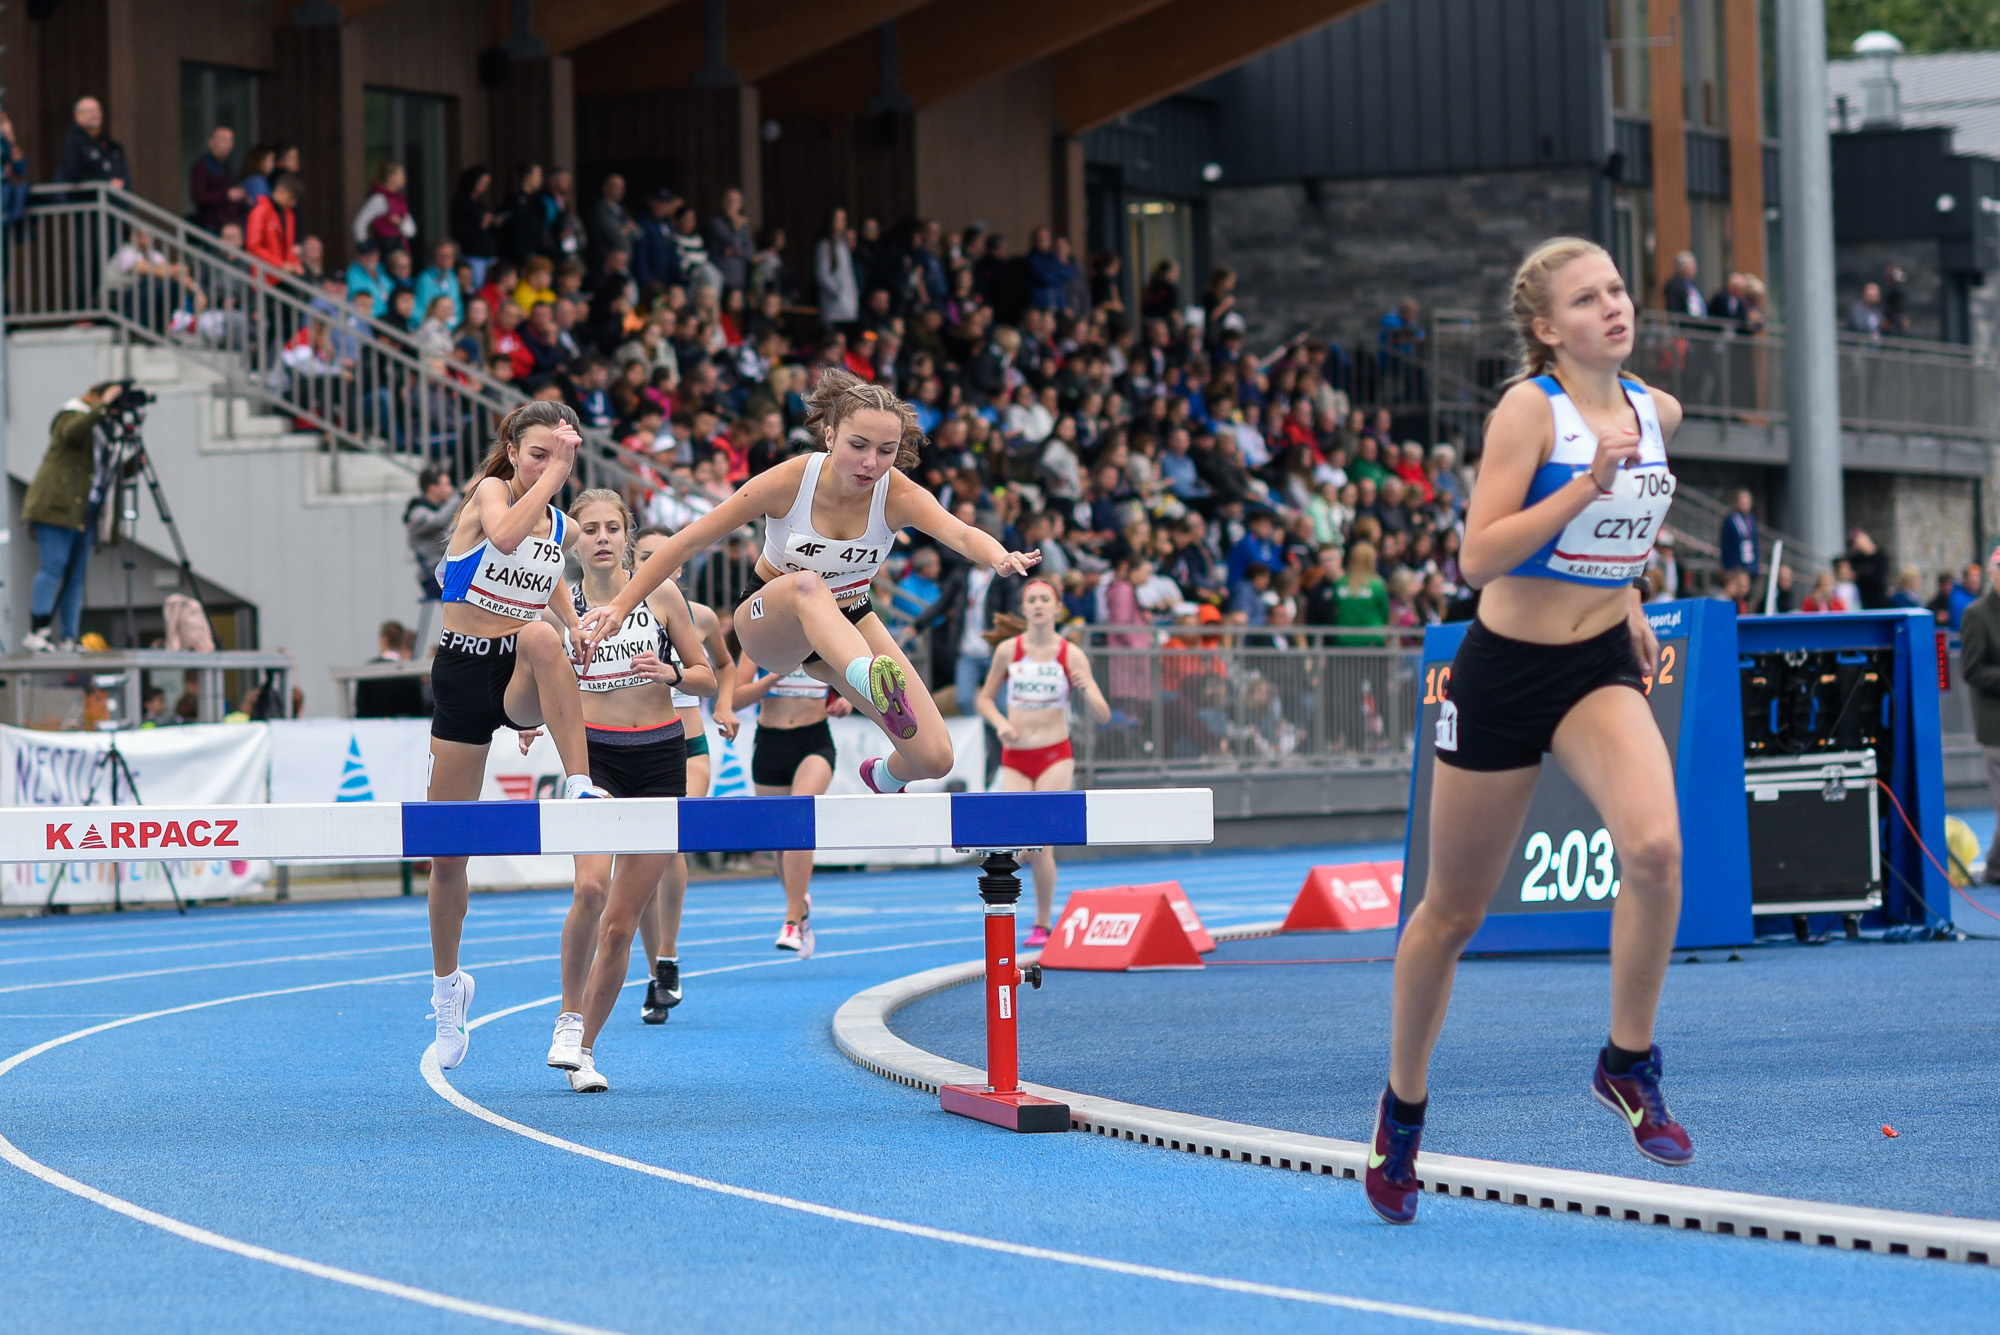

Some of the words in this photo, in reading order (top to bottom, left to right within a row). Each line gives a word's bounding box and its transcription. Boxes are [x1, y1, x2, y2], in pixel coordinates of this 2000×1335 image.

[1634, 473, 1671, 499] 706
[1593, 510, 1653, 540] CZYŻ
[532, 541, 561, 563] 795
[795, 542, 826, 557] 4F
[839, 547, 878, 564] 471
[484, 562, 552, 593] ŁAŃSKA
[1568, 563, 1624, 578] KARPACZ
[478, 597, 522, 617] KARPACZ
[627, 611, 649, 630] 70
[449, 633, 491, 656] PRO
[1658, 645, 1676, 684] 2
[587, 681, 626, 690] KARPACZ
[1091, 919, 1135, 938] ORLEN
